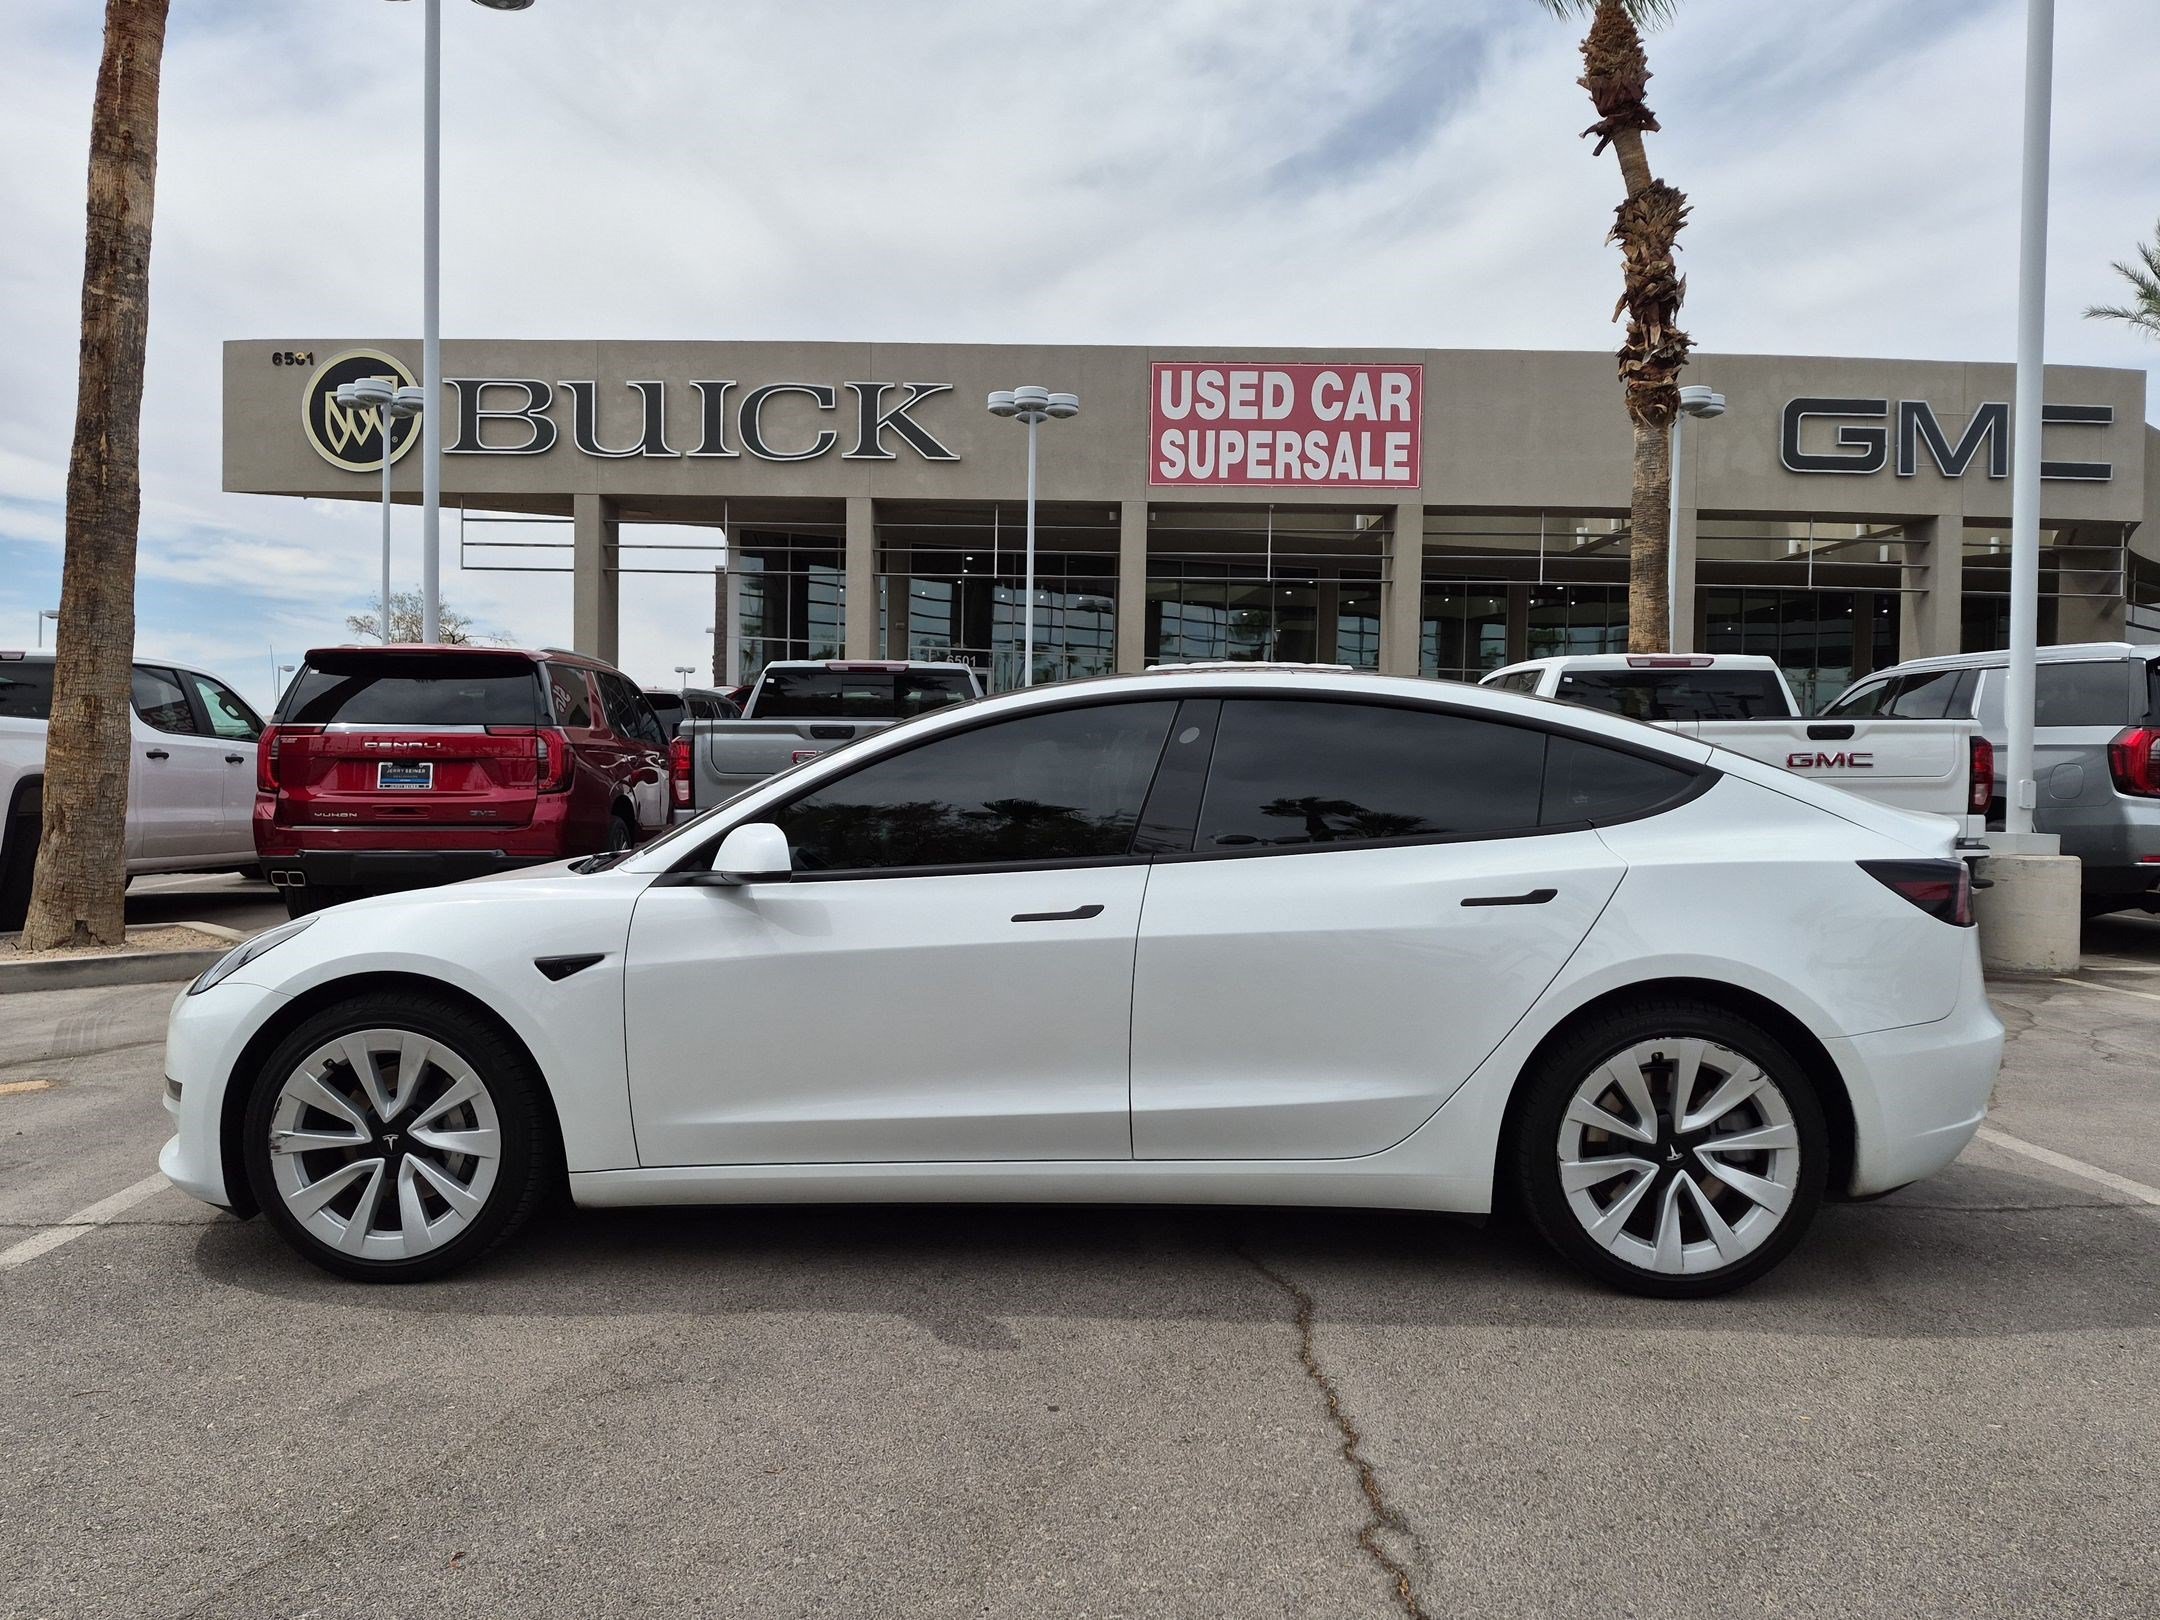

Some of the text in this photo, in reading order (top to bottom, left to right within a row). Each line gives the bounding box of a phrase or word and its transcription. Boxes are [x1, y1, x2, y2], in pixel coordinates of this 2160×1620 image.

[441, 378, 961, 462] BUICK
[1160, 369, 1412, 421] USED CAR
[1159, 428, 1412, 481] SUPERSALE
[946, 655, 976, 667] 6501
[1786, 752, 1874, 768] GMC
